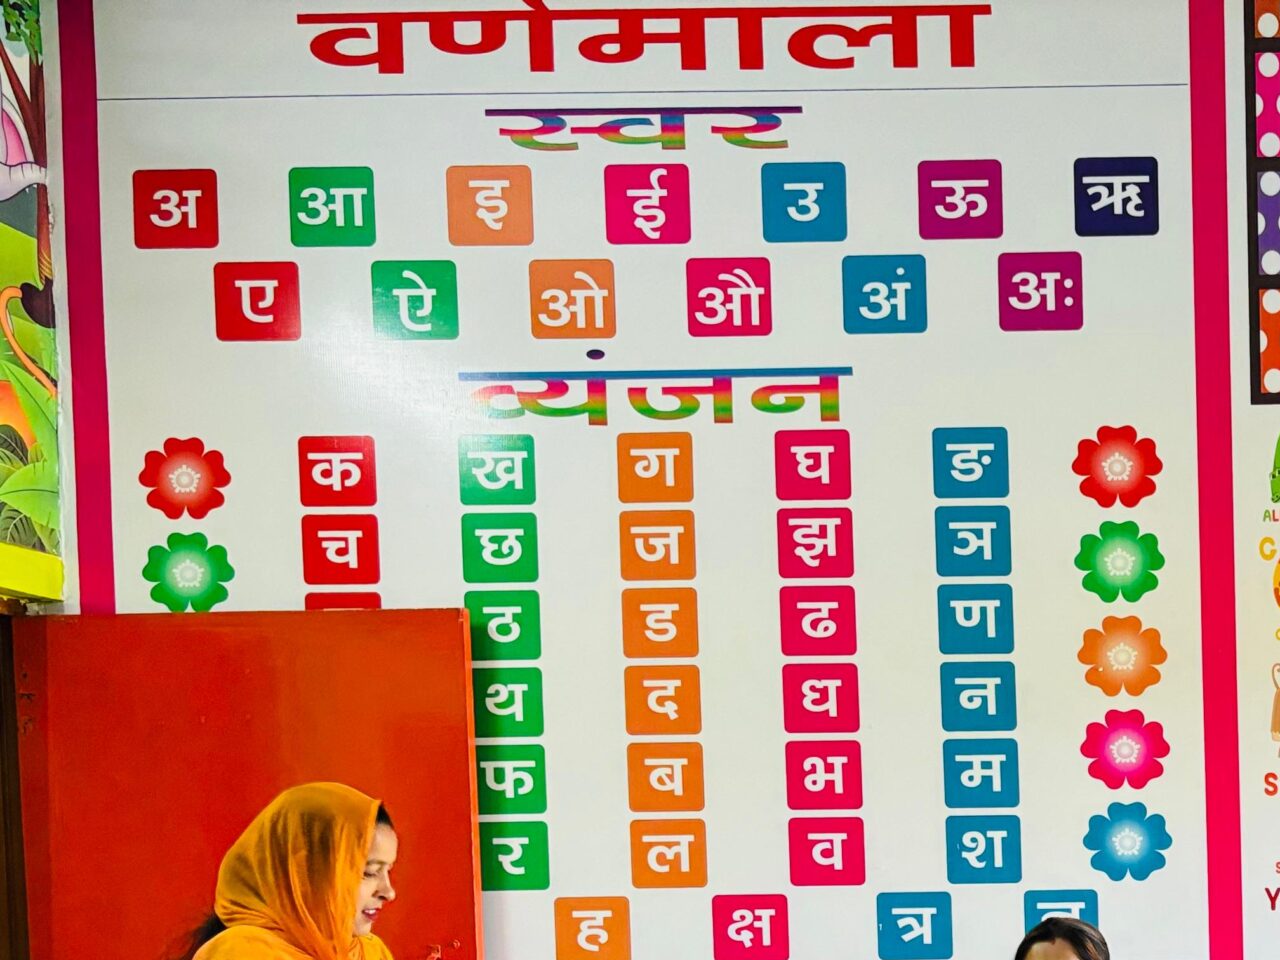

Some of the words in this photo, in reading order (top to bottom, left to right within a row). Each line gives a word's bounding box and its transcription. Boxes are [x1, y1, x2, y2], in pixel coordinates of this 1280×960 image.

[484, 106, 803, 152] स्वर
[150, 190, 201, 228] अ
[298, 188, 367, 226] आ
[469, 180, 509, 230] इ
[627, 169, 667, 238] ई
[784, 183, 823, 221] उ
[931, 180, 988, 218] ऊ
[1083, 176, 1149, 216] ऋ
[235, 280, 278, 322] ए
[392, 270, 436, 332] ऐ
[539, 272, 608, 328] ओ
[695, 269, 764, 325] औ
[860, 268, 911, 320] अं
[1009, 272, 1073, 310] अः
[458, 348, 853, 426] व्यंजन
[308, 453, 363, 490] क
[467, 450, 527, 491] ख
[630, 448, 679, 486] ग
[791, 446, 834, 483] घ
[946, 444, 994, 481] ङ
[318, 531, 362, 568] च
[475, 529, 523, 565] छ
[631, 526, 684, 564] ज
[789, 518, 841, 566] झ
[949, 522, 996, 560] ञ
[483, 607, 521, 646] ठ
[640, 604, 679, 641] ड
[797, 602, 838, 637] ढ
[950, 600, 1000, 637] ण
[485, 682, 528, 722] थ
[643, 680, 681, 720] द
[802, 680, 841, 716] ध
[955, 678, 1001, 715] न
[480, 759, 535, 798] फ
[645, 758, 687, 795] ब
[804, 757, 847, 793] भ
[955, 755, 1006, 791] म
[492, 836, 529, 876] र
[642, 835, 694, 872] ल
[808, 833, 847, 869] व
[962, 831, 1007, 868] श
[572, 910, 612, 951] ह
[728, 909, 775, 947] क्ष
[892, 908, 936, 944] त्र
